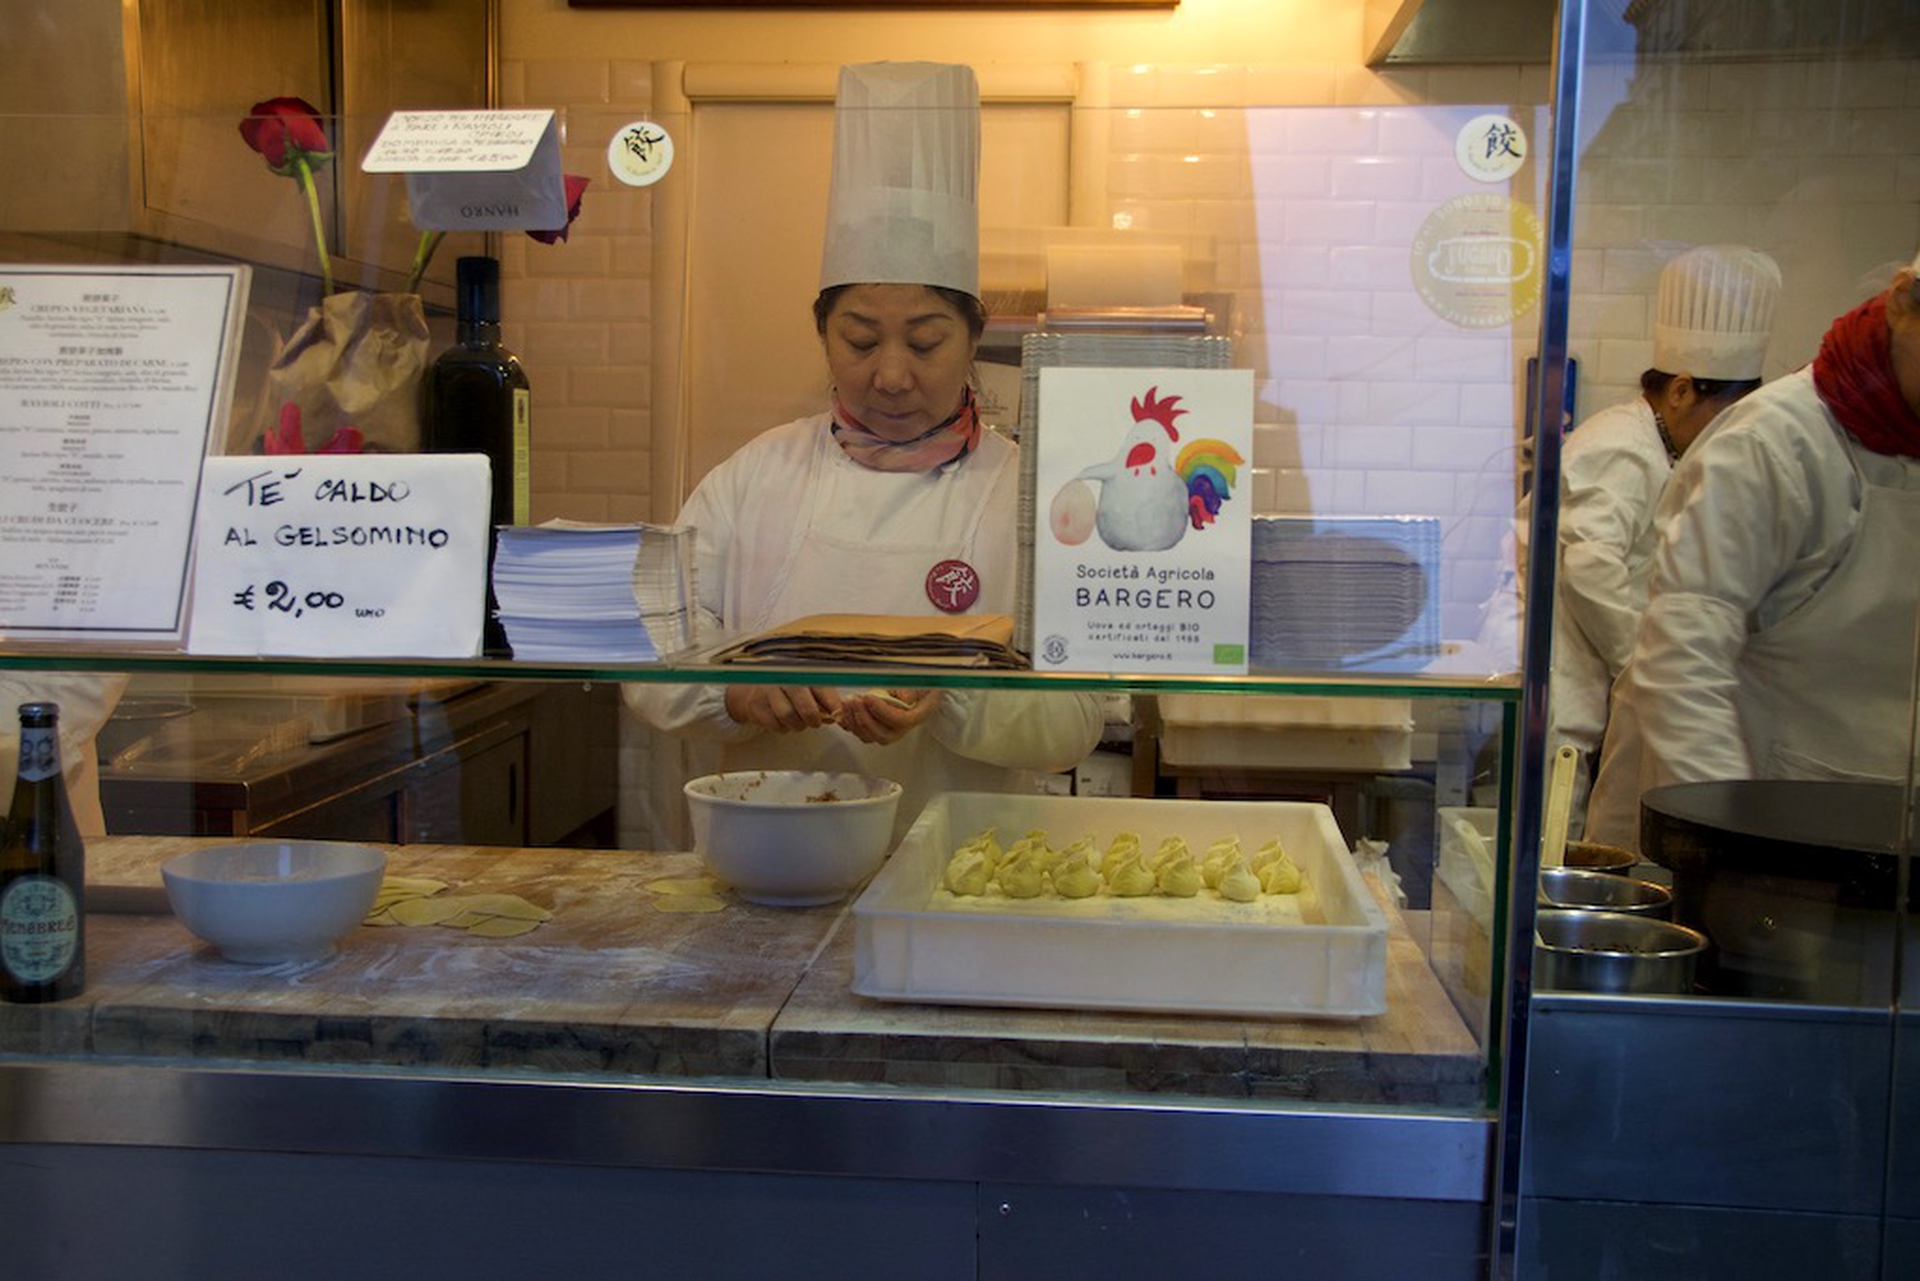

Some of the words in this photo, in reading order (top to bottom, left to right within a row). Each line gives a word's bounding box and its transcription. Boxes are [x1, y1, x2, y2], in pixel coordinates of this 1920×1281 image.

[460, 205, 519, 218] HANRO
[315, 479, 411, 503] CALDO
[224, 527, 257, 546] AL
[275, 524, 450, 549] GELSOMINO
[1076, 564, 1139, 580] Società
[1146, 566, 1215, 584] Agricola
[1076, 588, 1216, 610] BARGERO
[1087, 632, 1149, 642] certificati
[1153, 633, 1170, 642] dal
[1135, 622, 1175, 633] ortaggi
[1179, 622, 1200, 632] BIO
